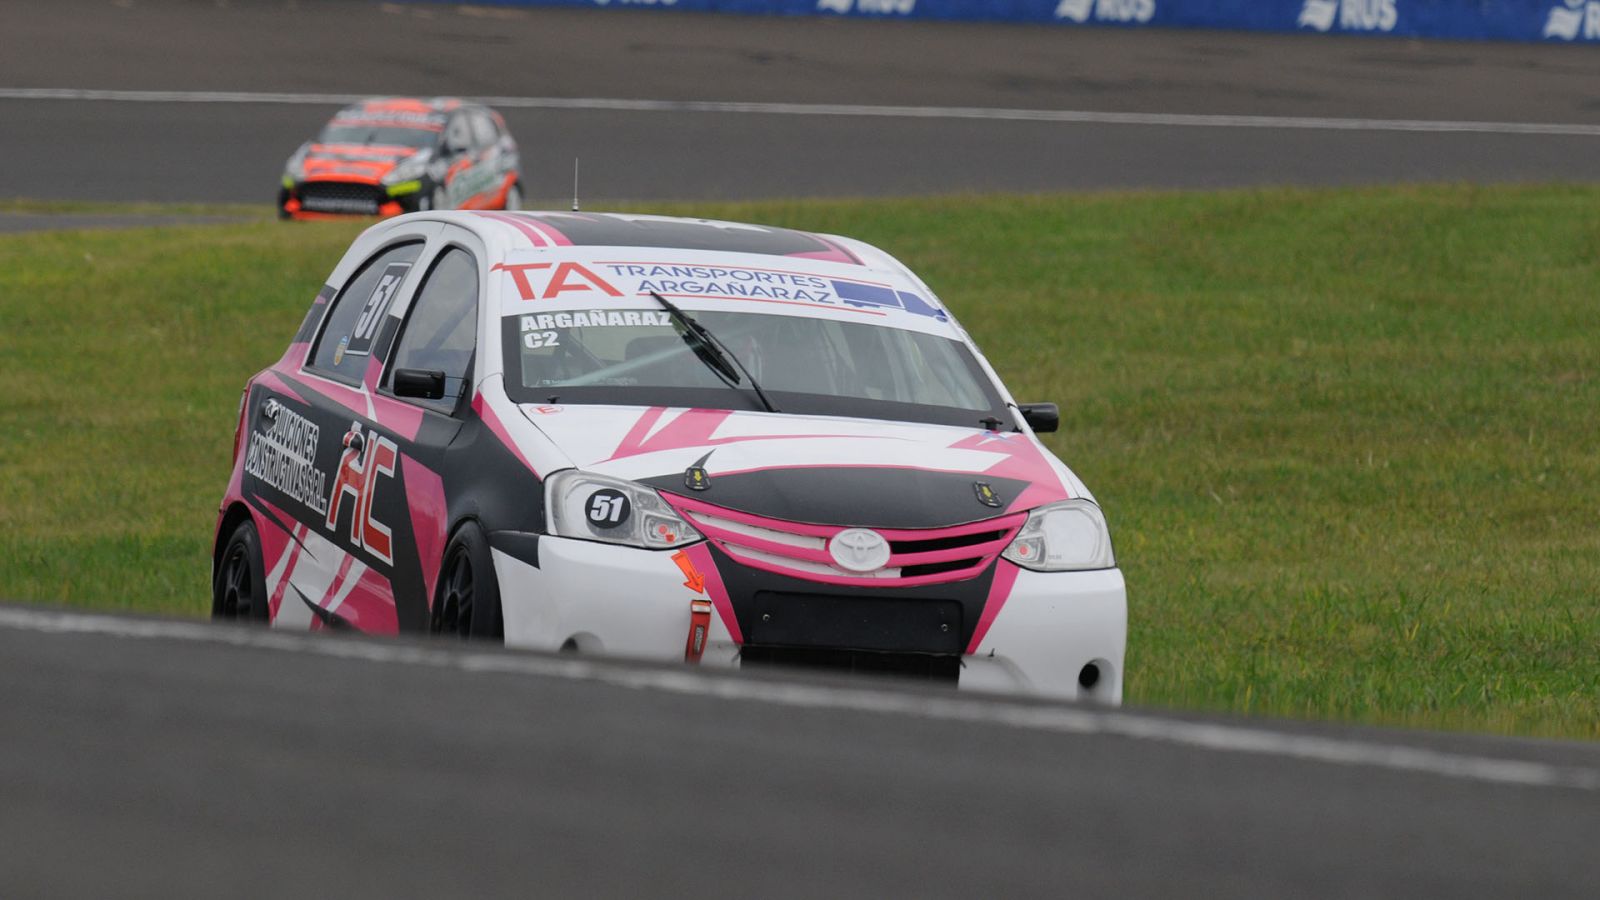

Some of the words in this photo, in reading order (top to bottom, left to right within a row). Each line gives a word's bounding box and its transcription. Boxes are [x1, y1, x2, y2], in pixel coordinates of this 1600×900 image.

[1340, 0, 1398, 31] RUS
[490, 262, 625, 300] TA
[607, 265, 826, 288] TRANSPORTES
[638, 280, 835, 304] ARGAÑARAZ
[354, 274, 402, 340] 51
[520, 310, 673, 331] ARGAÑARAZ
[524, 332, 560, 349] C2
[590, 495, 624, 522] 51
